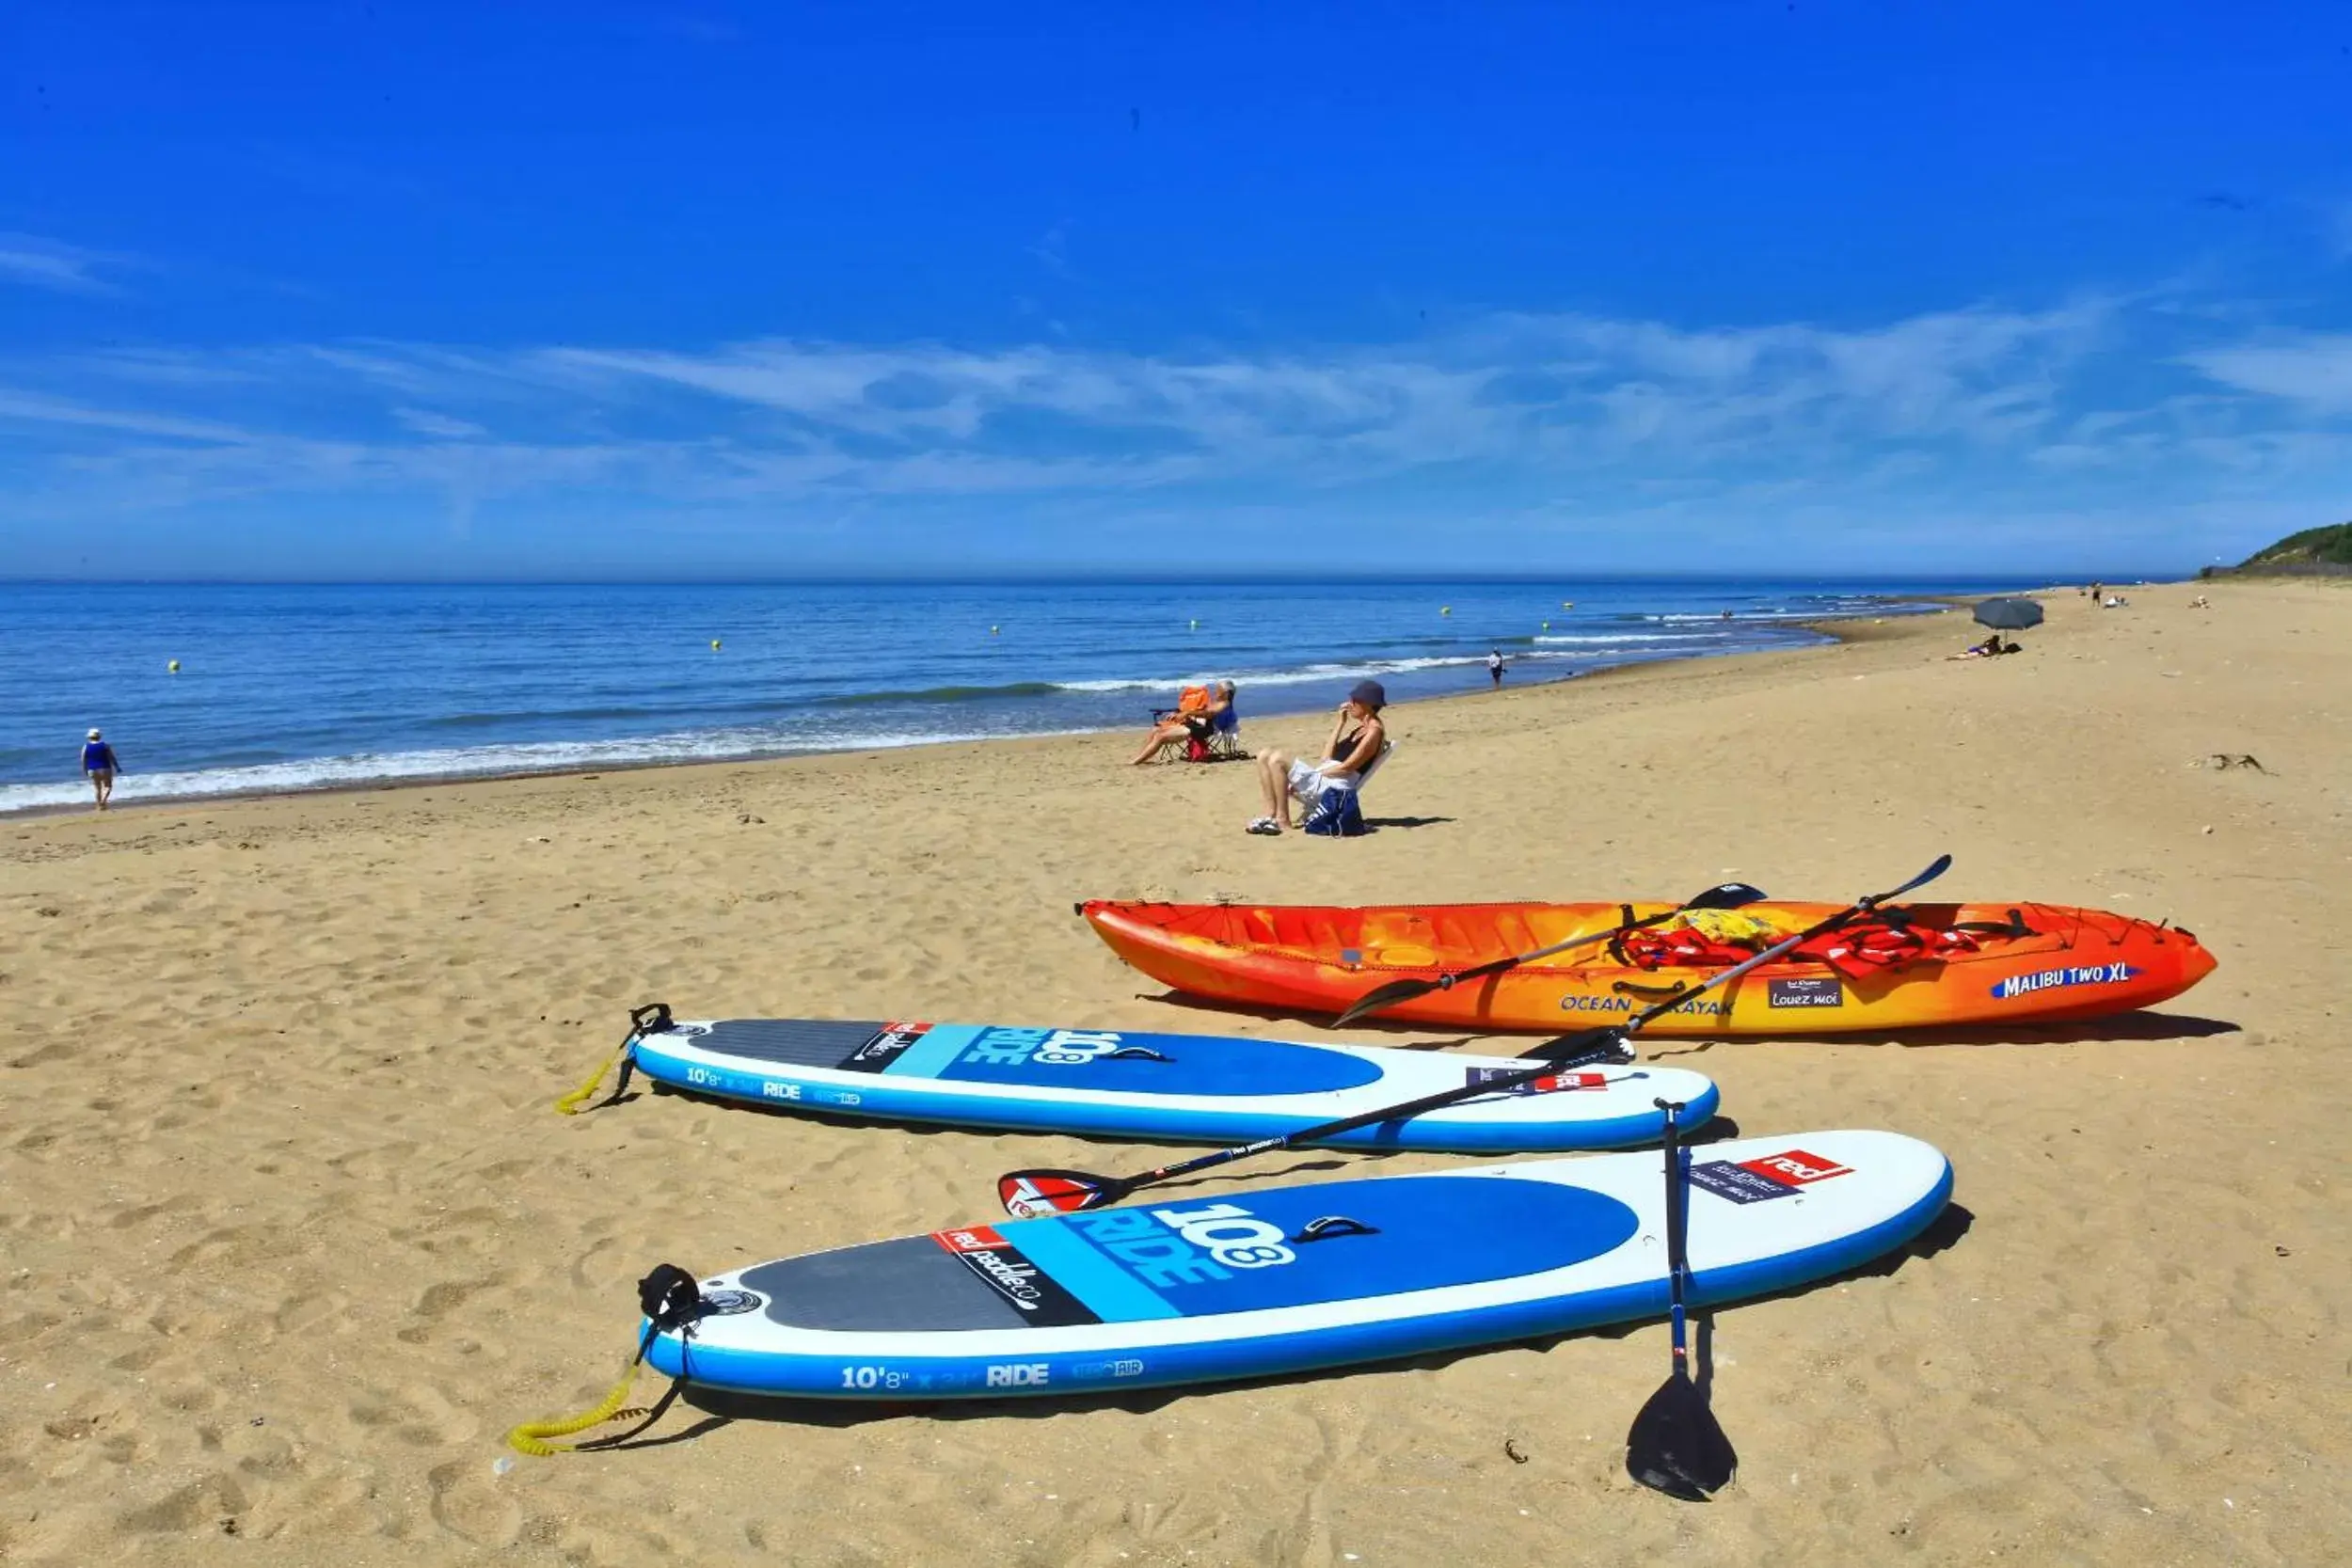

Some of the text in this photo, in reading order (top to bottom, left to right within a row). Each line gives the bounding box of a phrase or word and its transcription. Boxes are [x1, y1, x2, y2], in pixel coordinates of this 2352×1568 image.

[2004, 961, 2130, 998] MALIBU TWO XL
[1560, 995, 1631, 1012] OCEAN
[763, 1082, 801, 1099] RIDE
[1067, 1209, 1234, 1288] RIDE
[987, 1363, 1050, 1386] RIDE
